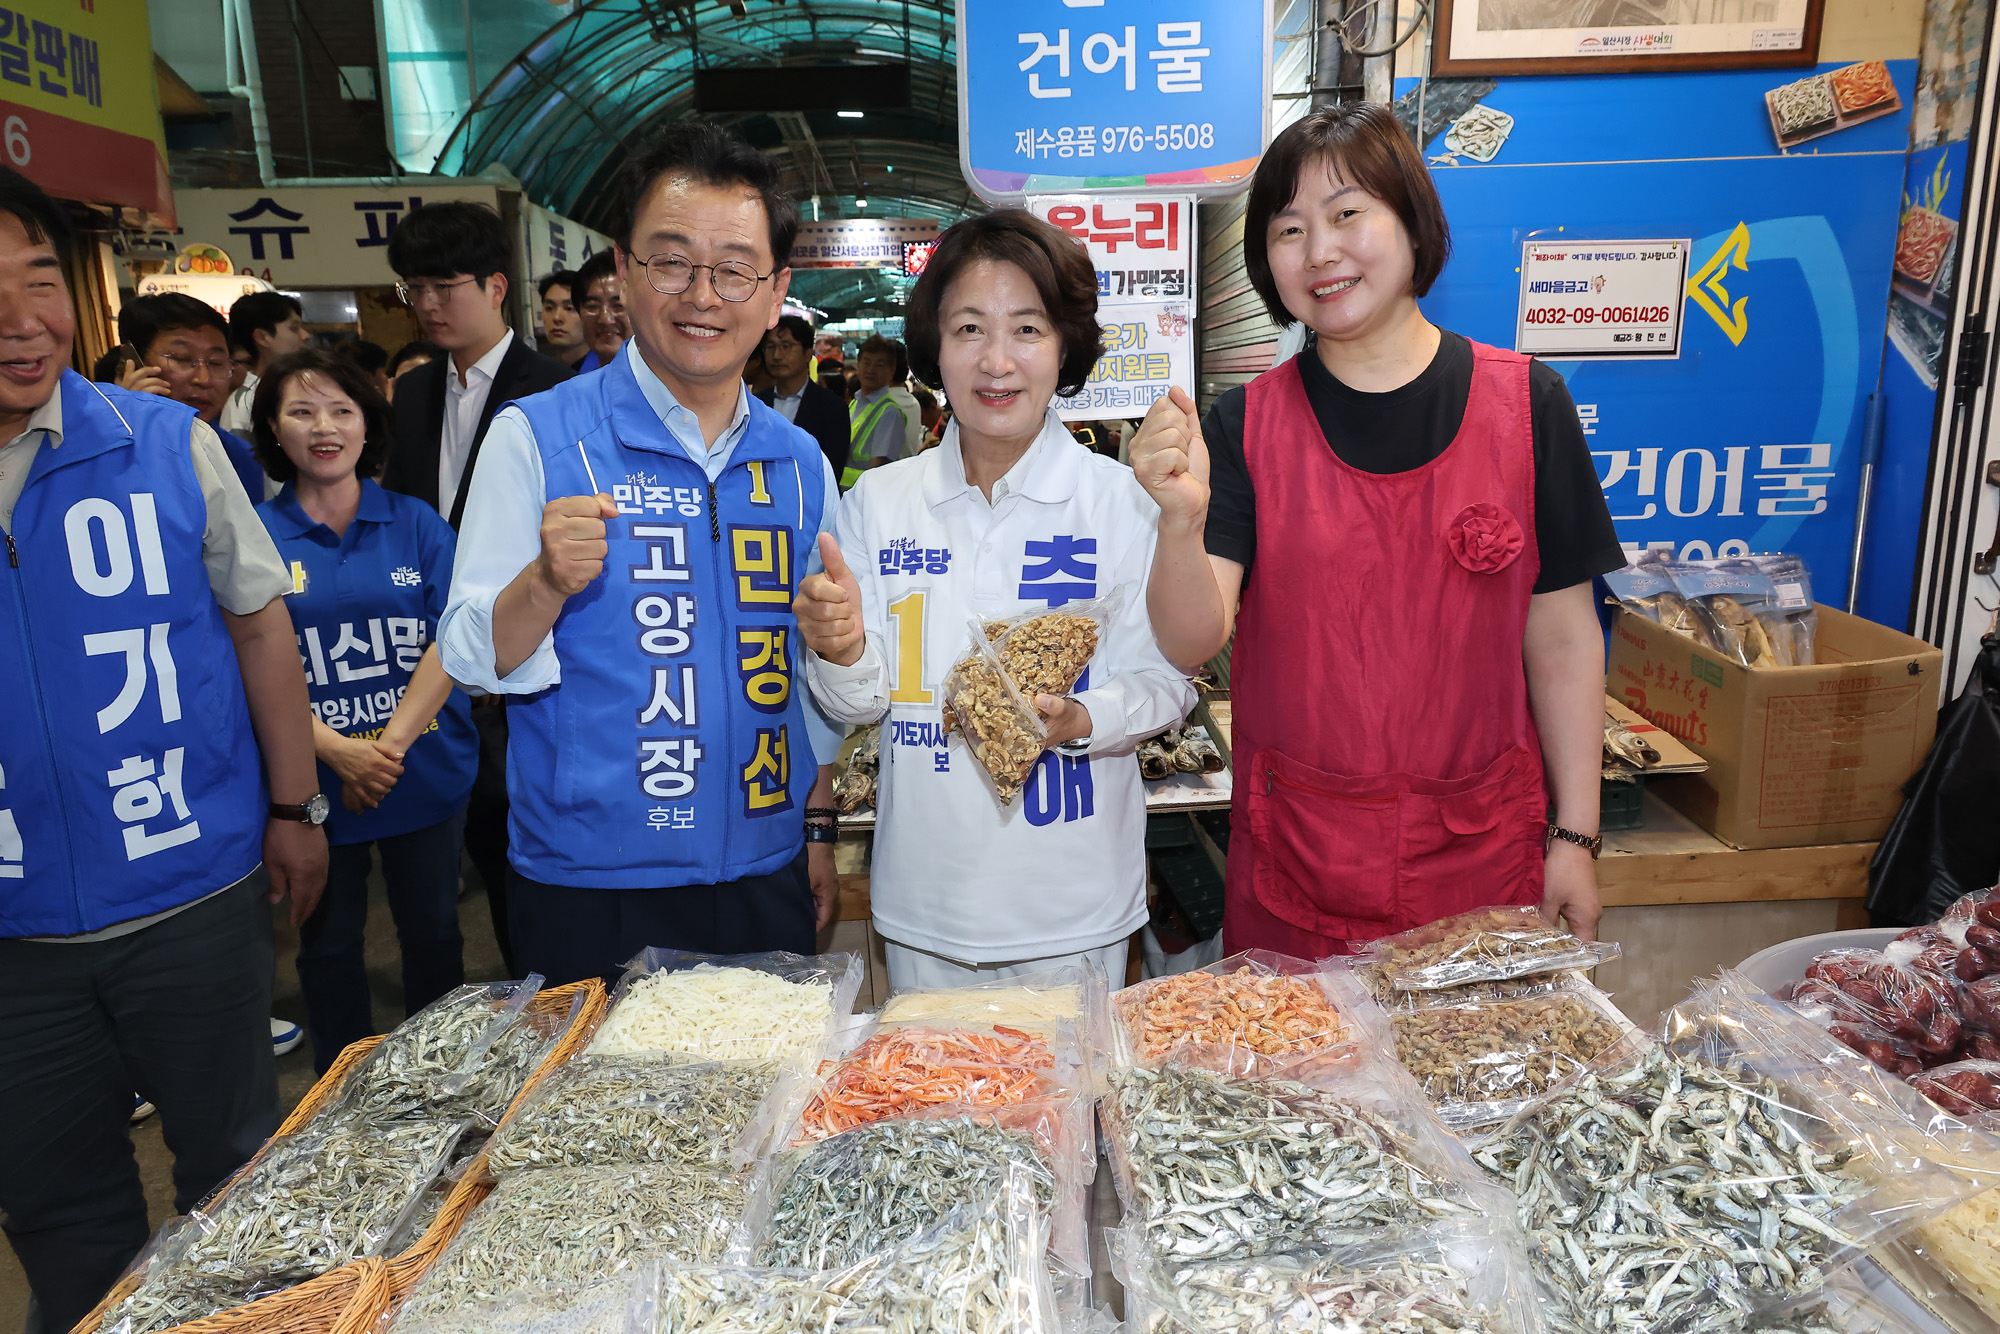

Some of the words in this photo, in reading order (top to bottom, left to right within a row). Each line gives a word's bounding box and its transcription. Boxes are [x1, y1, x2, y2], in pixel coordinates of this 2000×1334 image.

[1018, 21, 1210, 98] 건어물
[1015, 126, 1097, 159] 제수용품
[1101, 122, 1215, 153] 976-5508
[821, 244, 904, 257] 일산서문상점가입
[1594, 253, 1638, 261] 부탁드립니다.
[1640, 252, 1678, 261] 감사합니다.
[1529, 281, 1588, 293] 새마을금고
[1526, 306, 1669, 324] 4032-09-0061426
[1094, 386, 1130, 408] 가능
[625, 471, 658, 487] 더불어
[746, 461, 773, 505] 1
[1590, 443, 1836, 520] 건어물
[613, 484, 703, 517] 민주당
[889, 536, 916, 552] 더불어
[879, 548, 952, 575] 민주당
[390, 571, 422, 587] 민주
[633, 526, 700, 797] 고양시장
[888, 589, 932, 706] 1
[63, 493, 201, 862] 이기헌
[732, 529, 791, 812] 민경선
[1017, 535, 1098, 827] 추애
[646, 805, 695, 832] 후보
